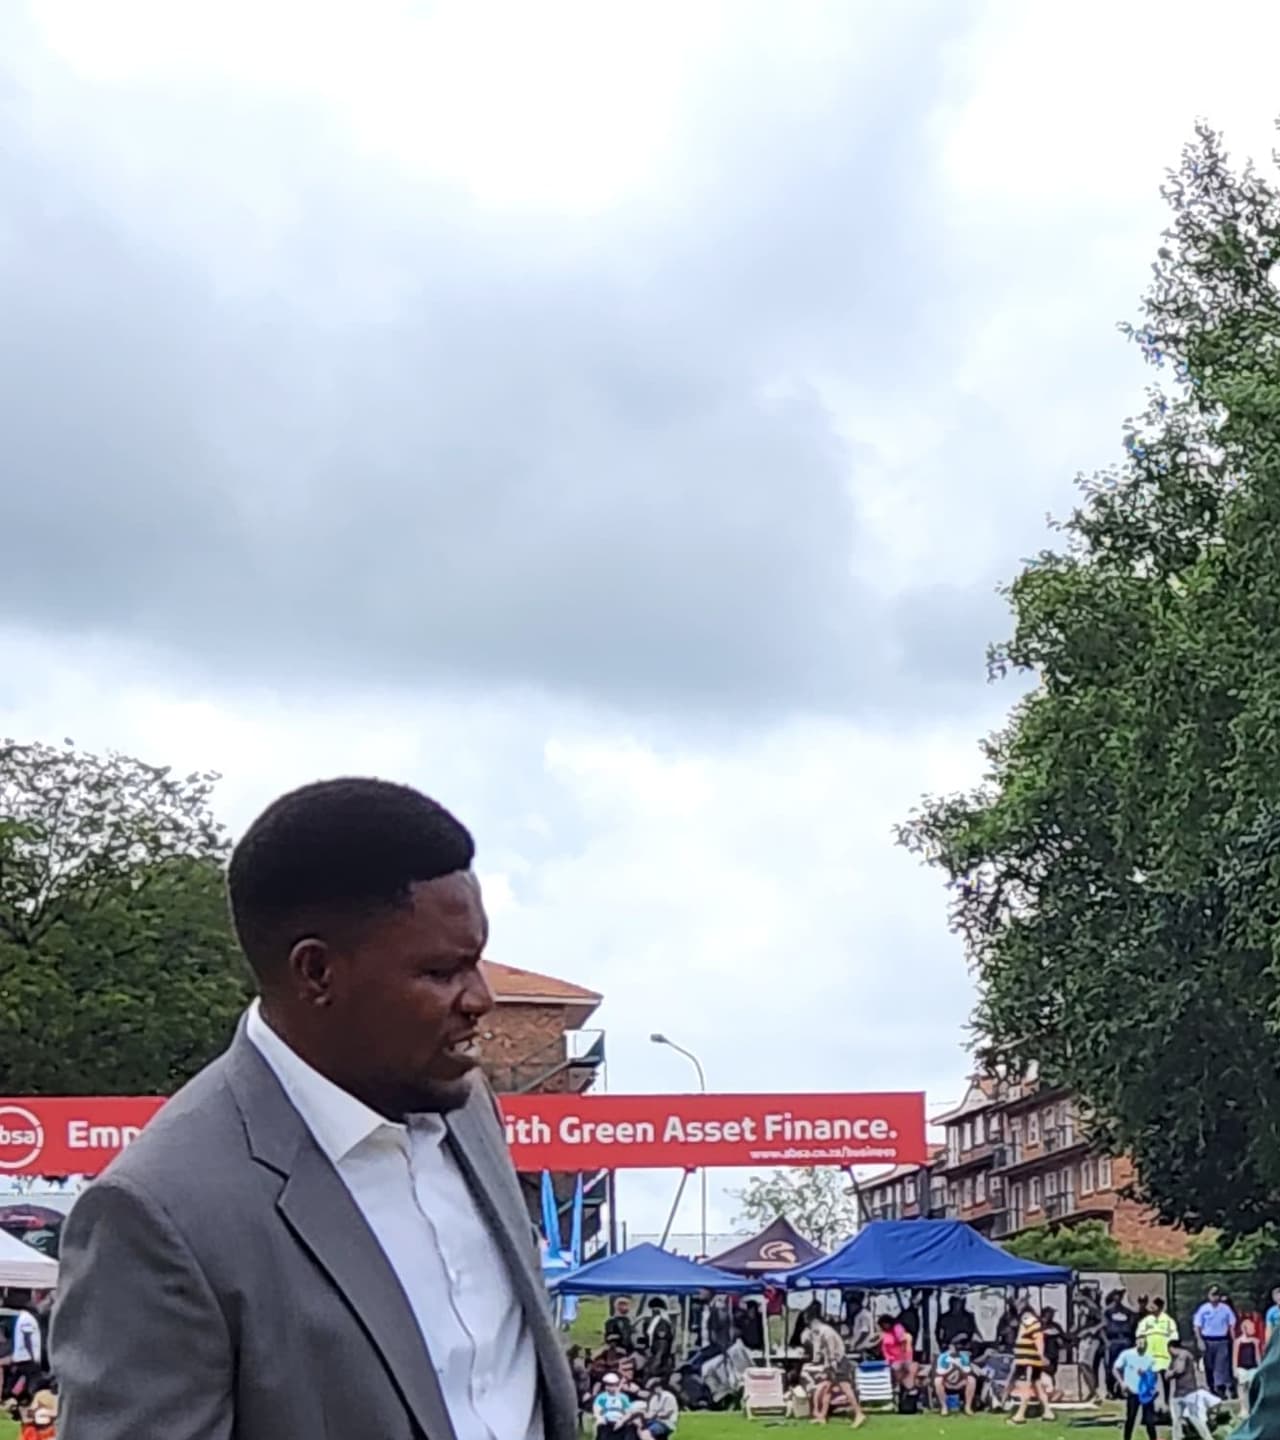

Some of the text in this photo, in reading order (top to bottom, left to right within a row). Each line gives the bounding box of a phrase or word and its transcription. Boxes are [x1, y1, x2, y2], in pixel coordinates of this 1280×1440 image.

[0, 1123, 36, 1146] bsa
[68, 1120, 142, 1149] Emp
[504, 1112, 898, 1145] ith Green Asset Finance.
